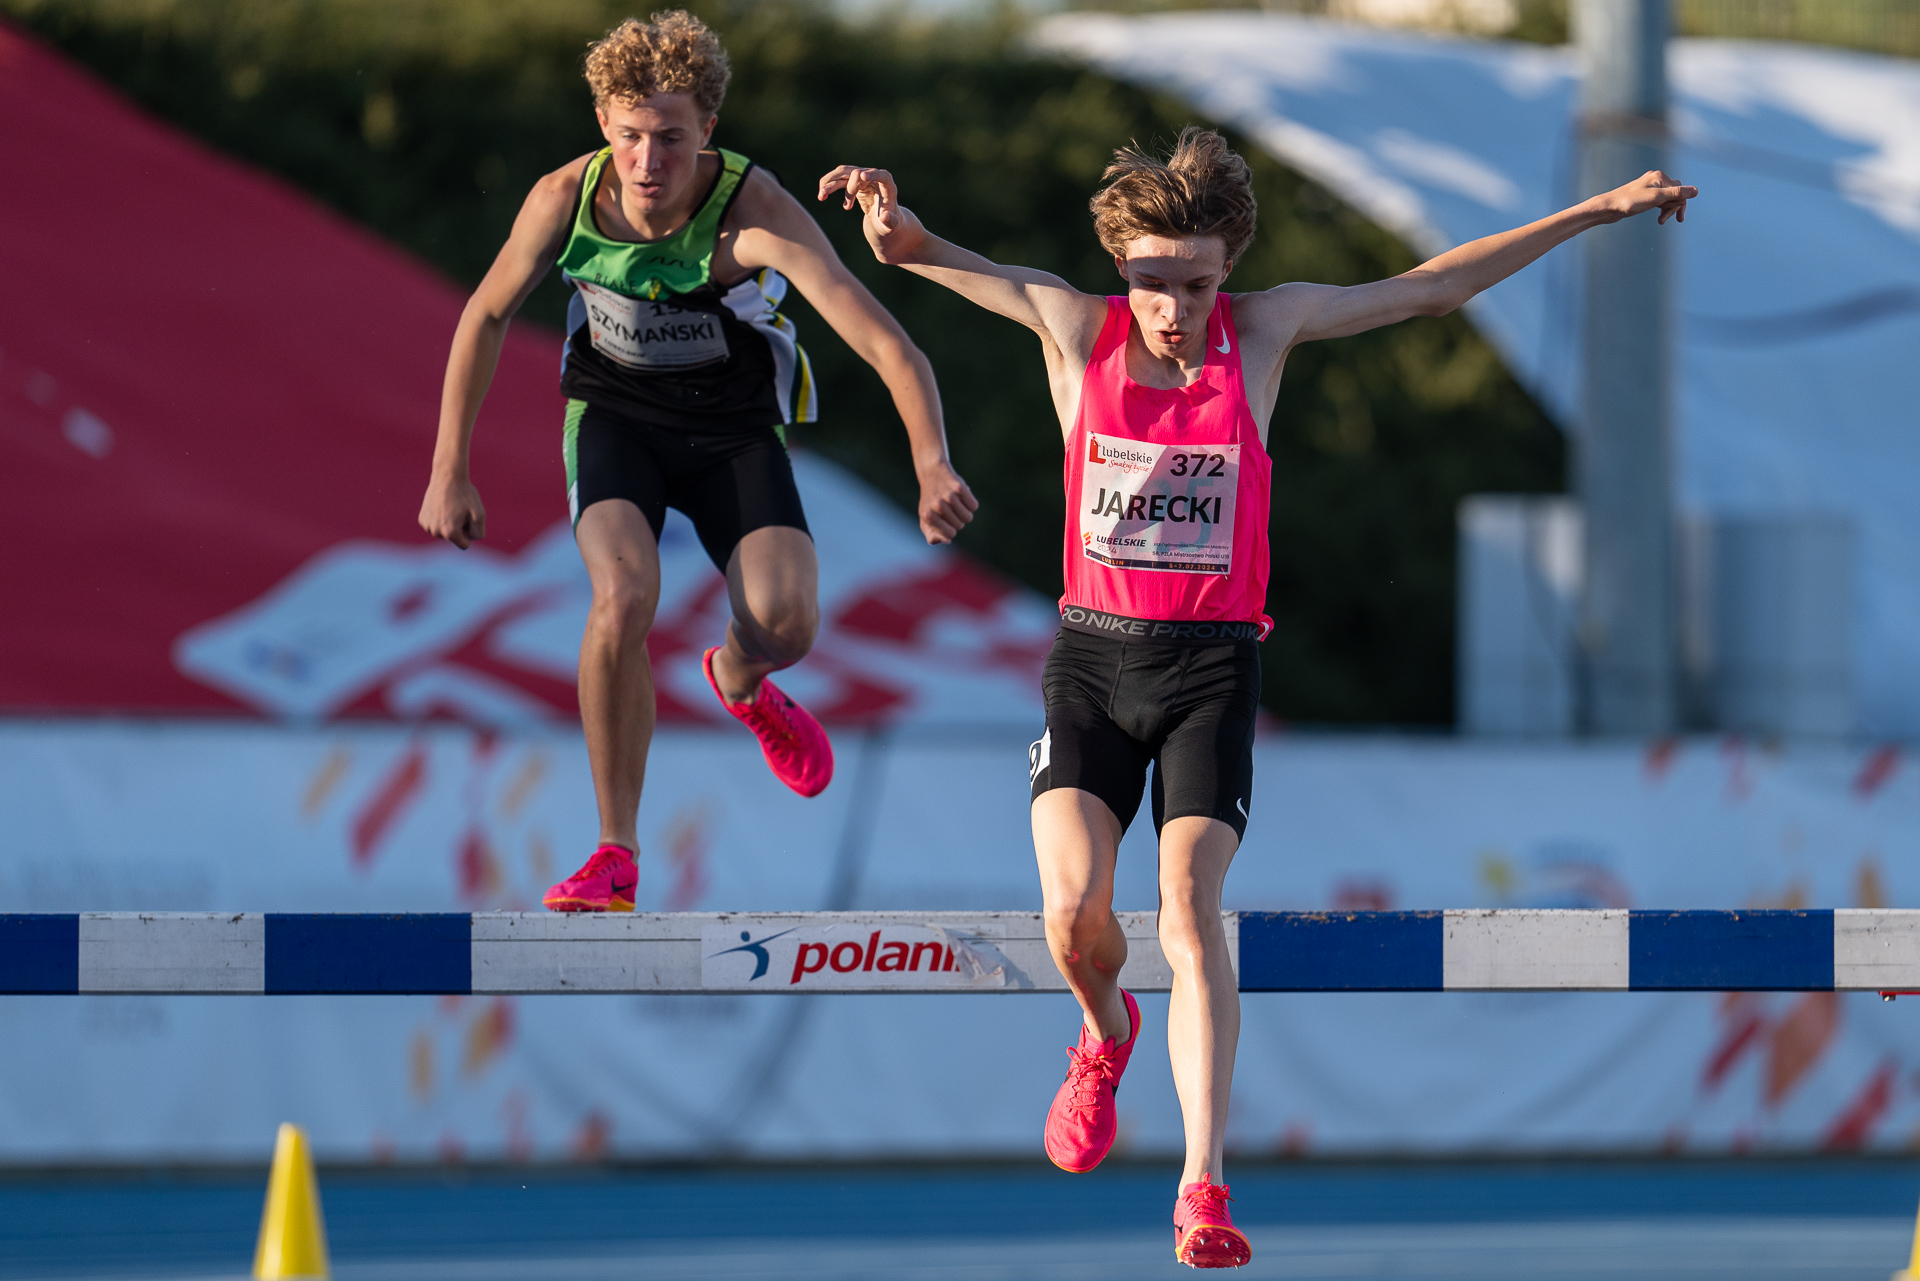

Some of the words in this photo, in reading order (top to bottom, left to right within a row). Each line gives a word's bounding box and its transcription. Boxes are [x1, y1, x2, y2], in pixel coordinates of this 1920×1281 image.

[649, 302, 701, 317] 15
[590, 304, 715, 344] SZYMAŃSKI
[1102, 445, 1153, 465] lubelskie
[1170, 453, 1226, 477] 372
[1091, 488, 1222, 524] JARECKI
[1096, 535, 1147, 547] LUBELSKIE
[1101, 556, 1124, 566] LUBLIN
[1085, 612, 1149, 636] NIKE
[1151, 622, 1217, 638] PRO
[790, 929, 961, 985] polani
